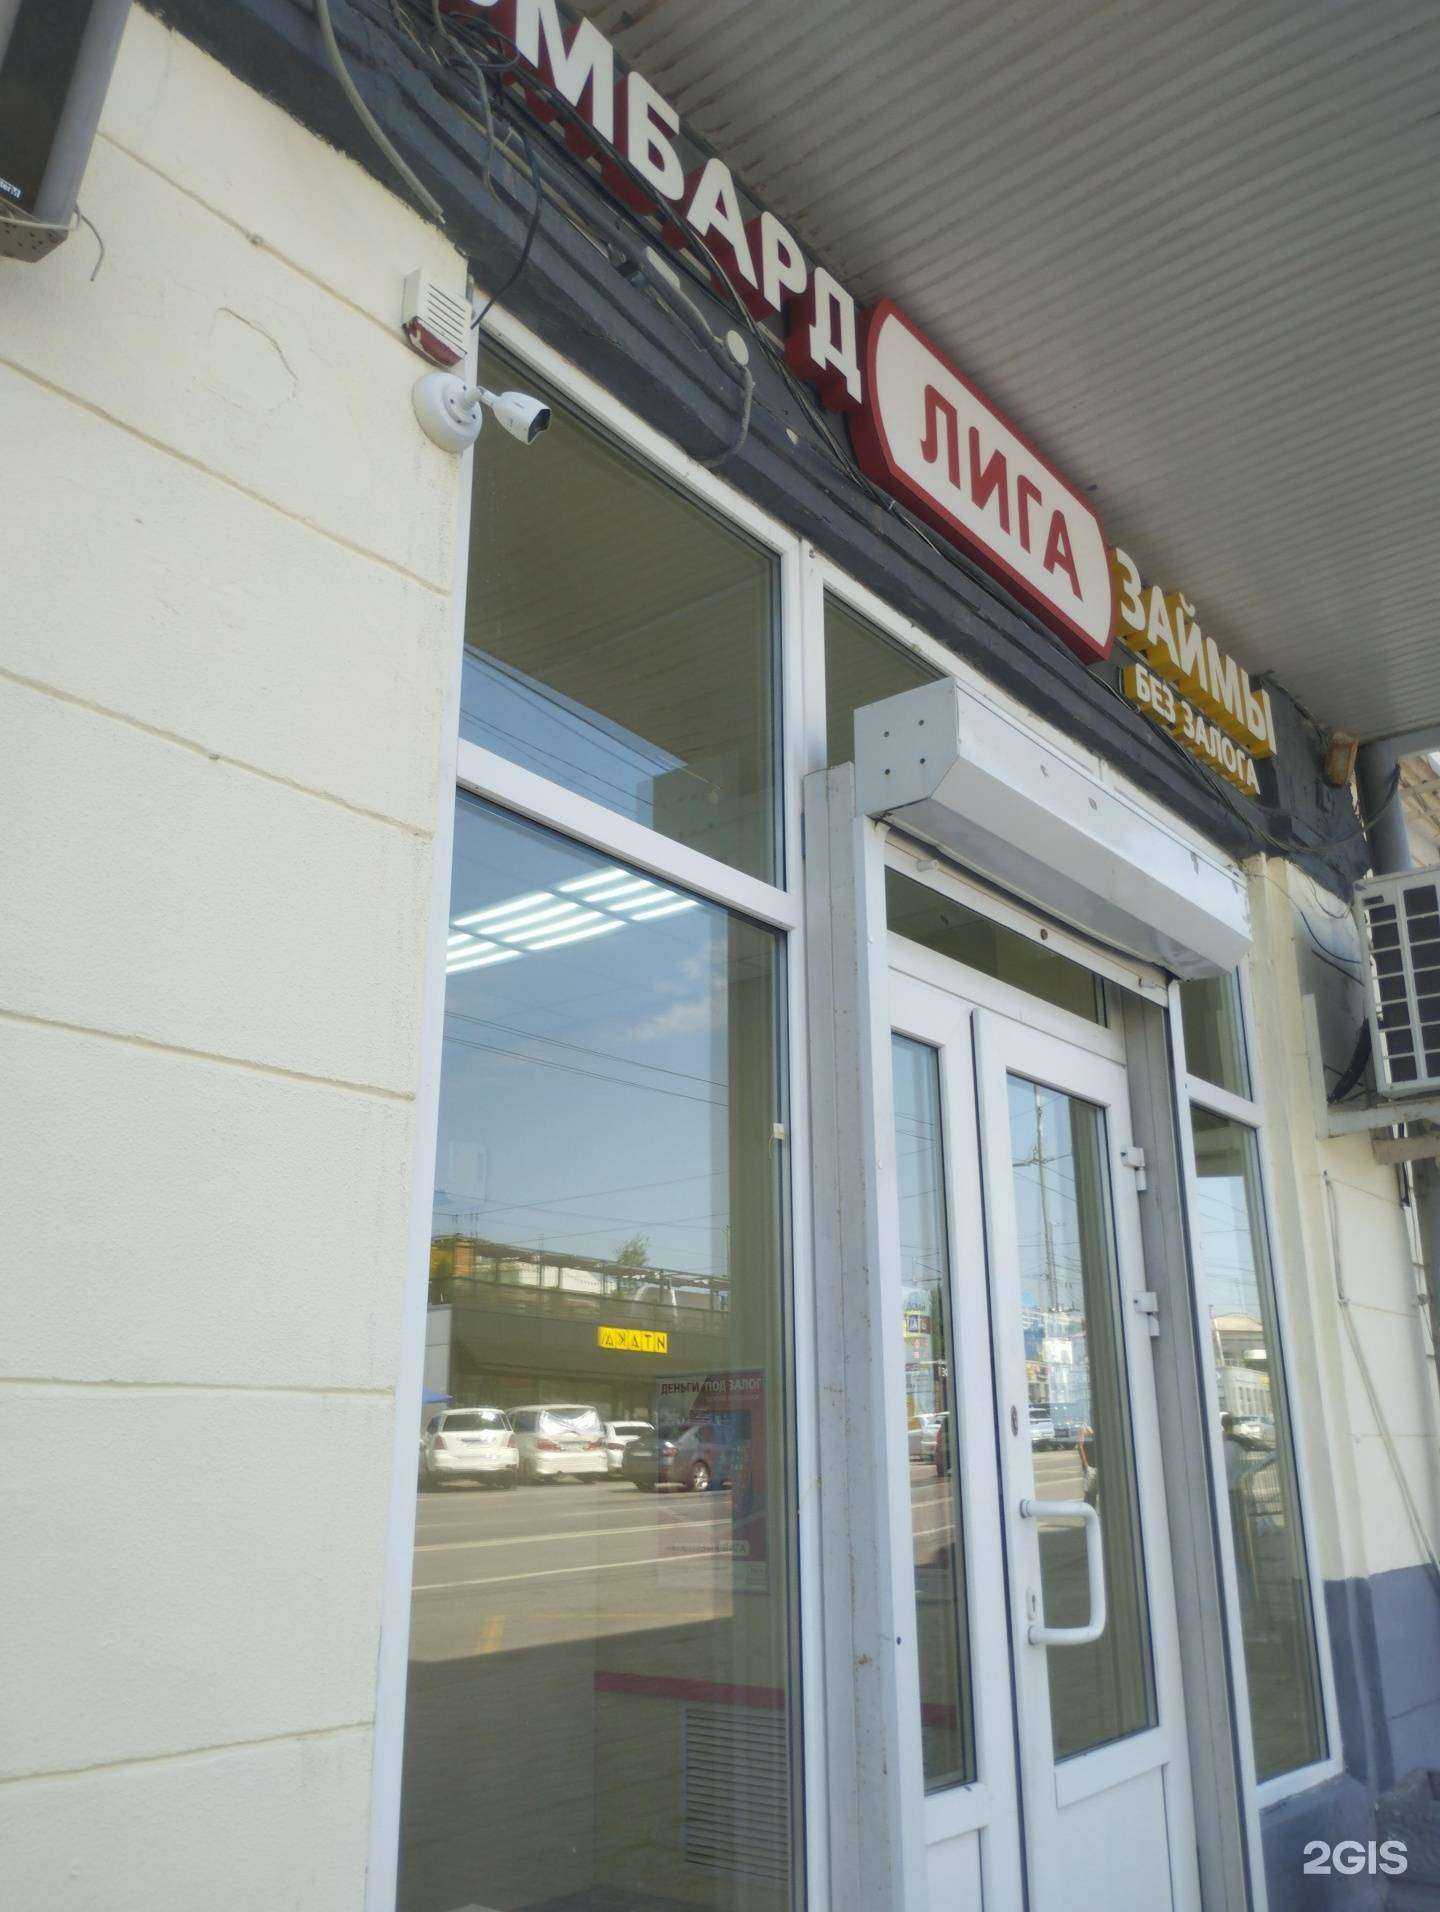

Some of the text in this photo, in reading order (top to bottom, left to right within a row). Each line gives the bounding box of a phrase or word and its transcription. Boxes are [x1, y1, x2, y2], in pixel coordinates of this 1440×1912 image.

[468, 0, 862, 404] МБАРД
[920, 384, 1083, 601] ЛИГА
[1116, 547, 1277, 755] ЗАЙМЫ
[1135, 662, 1261, 795] БЕЗ ЗАЛОГА
[661, 1382, 700, 1396] ДЕНЬГИ
